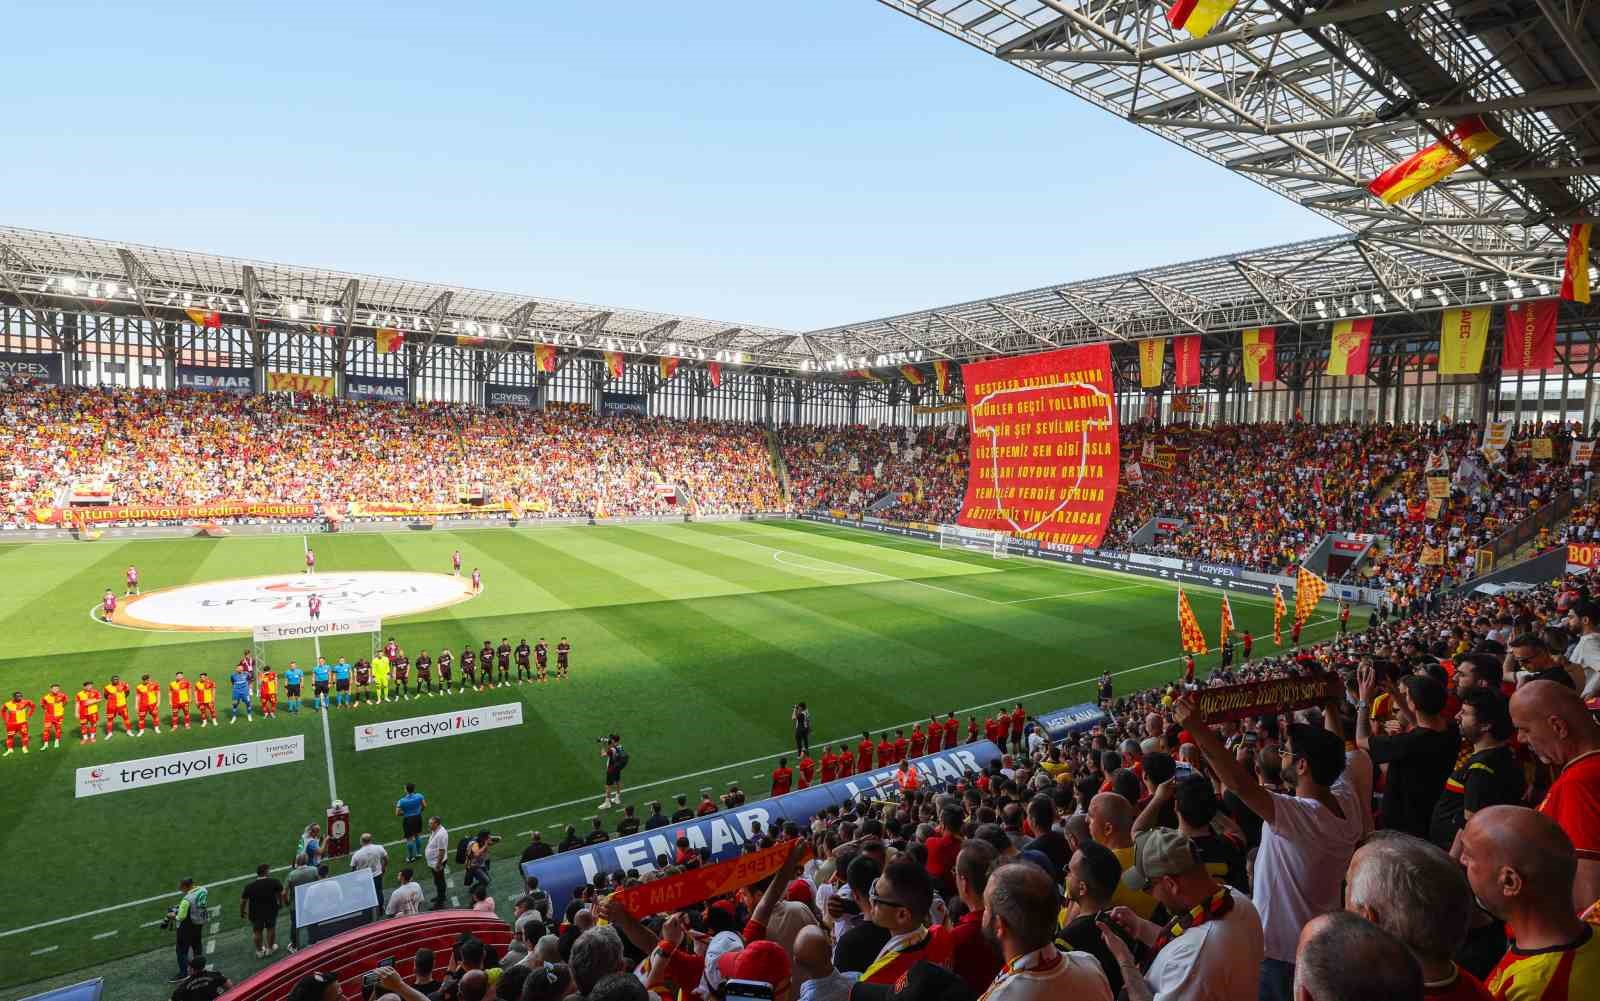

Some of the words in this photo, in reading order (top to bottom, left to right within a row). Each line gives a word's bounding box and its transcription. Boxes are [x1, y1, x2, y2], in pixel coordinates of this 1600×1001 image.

[182, 374, 250, 387] LEMAR
[349, 383, 405, 395] LEMAR
[1032, 445, 1052, 457] SEN
[1056, 442, 1079, 456] GİBİ
[277, 623, 329, 636] trendyol
[385, 718, 452, 740] trendyol
[120, 755, 211, 783] trendyol
